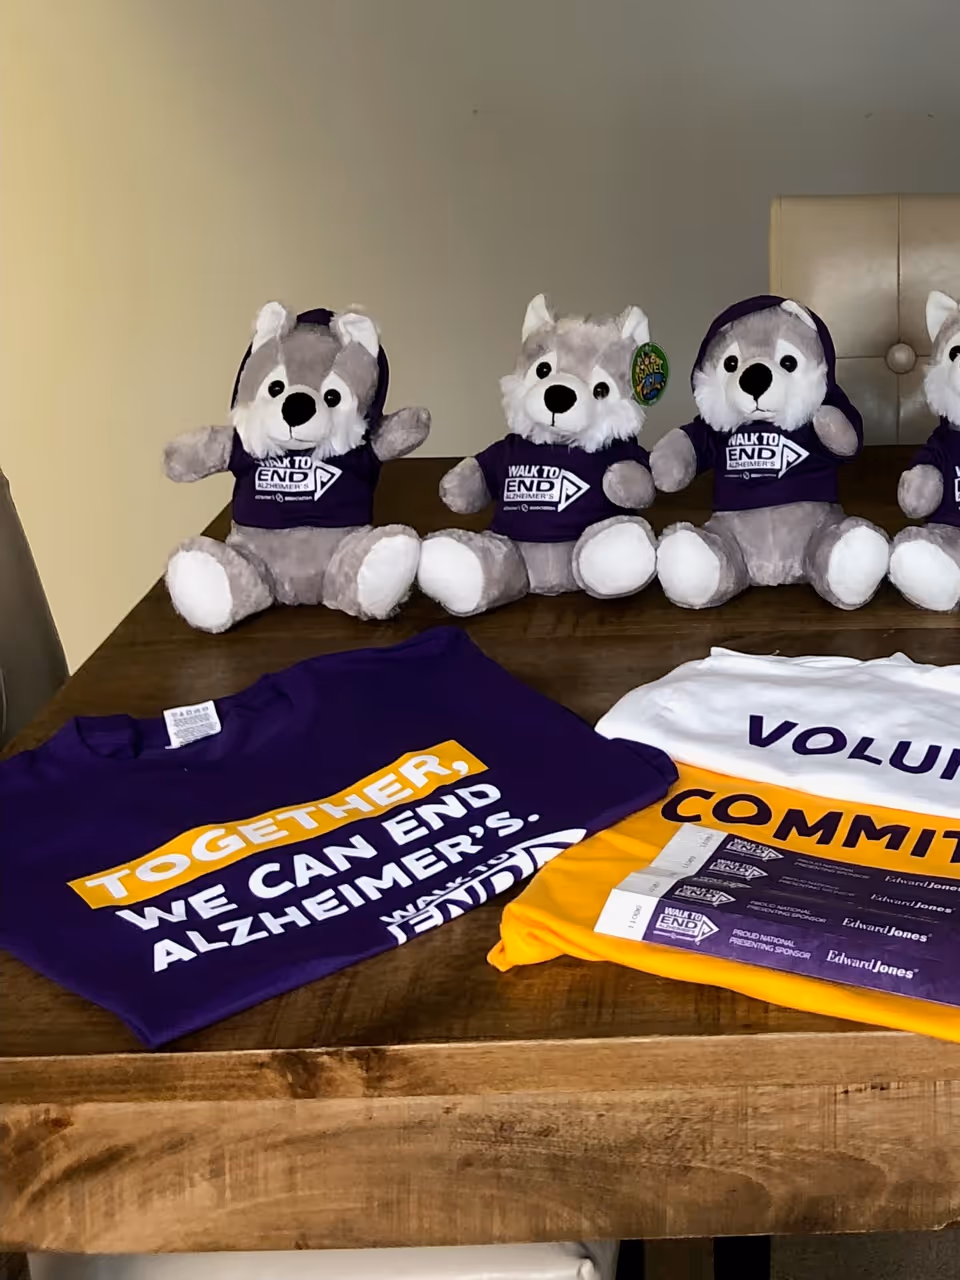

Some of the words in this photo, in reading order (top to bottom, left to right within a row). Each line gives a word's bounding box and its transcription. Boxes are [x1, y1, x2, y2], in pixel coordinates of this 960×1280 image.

[761, 432, 779, 446] TO
[728, 447, 776, 461] END
[293, 456, 312, 469] TO
[257, 468, 310, 483] END
[508, 465, 541, 478] WALK
[542, 465, 560, 479] TO
[506, 479, 556, 493] END
[84, 753, 470, 900] TOGETHER,
[115, 884, 239, 931] WE
[248, 834, 378, 900] CAN
[381, 782, 502, 847] END
[152, 810, 540, 972] ALZHEIMER'S.
[379, 876, 472, 924] WALK
[664, 906, 690, 919] WALK
[689, 911, 702, 921] TO
[660, 915, 699, 930] END
[732, 928, 760, 940] PROUD
[759, 934, 796, 948] NATIONAL
[728, 936, 774, 952] PRESENTING
[774, 945, 812, 960] SPONSOR
